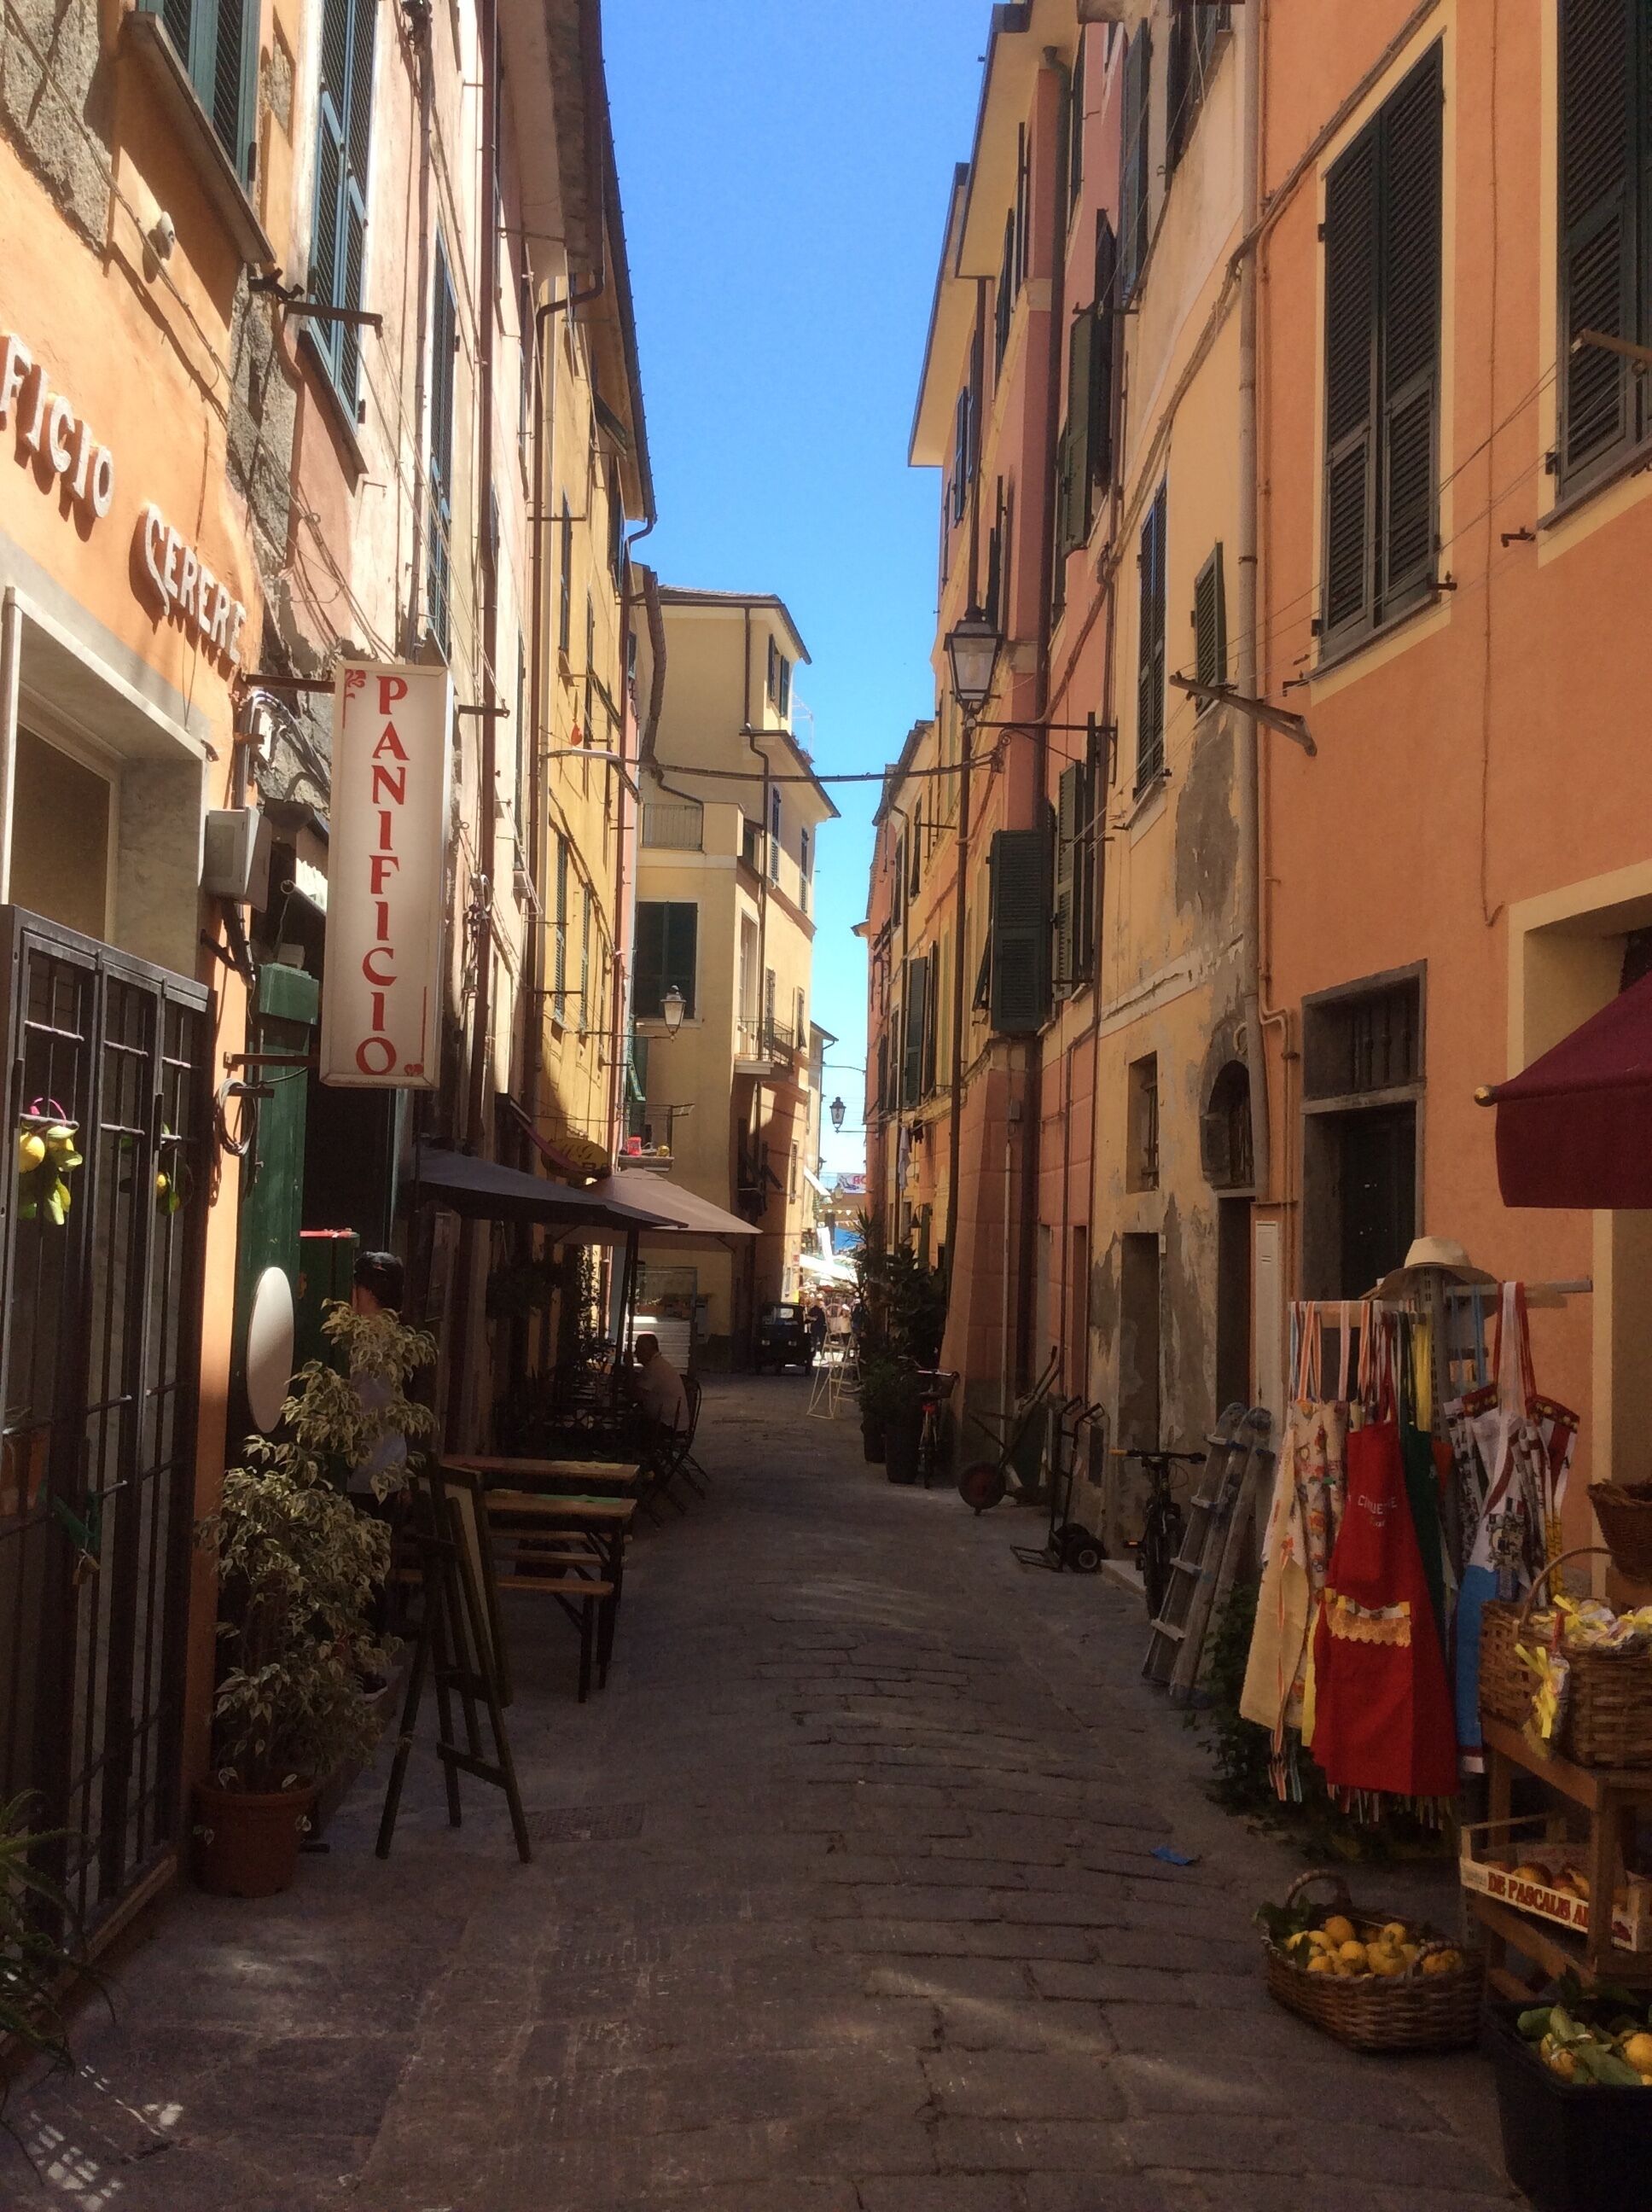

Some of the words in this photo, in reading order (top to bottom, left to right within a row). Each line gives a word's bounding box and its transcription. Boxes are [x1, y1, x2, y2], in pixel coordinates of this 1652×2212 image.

[0, 333, 113, 518] FICIO
[144, 504, 247, 666] CERERE
[355, 674, 410, 1077] PANIFICIO
[1487, 1871, 1506, 1897] DE
